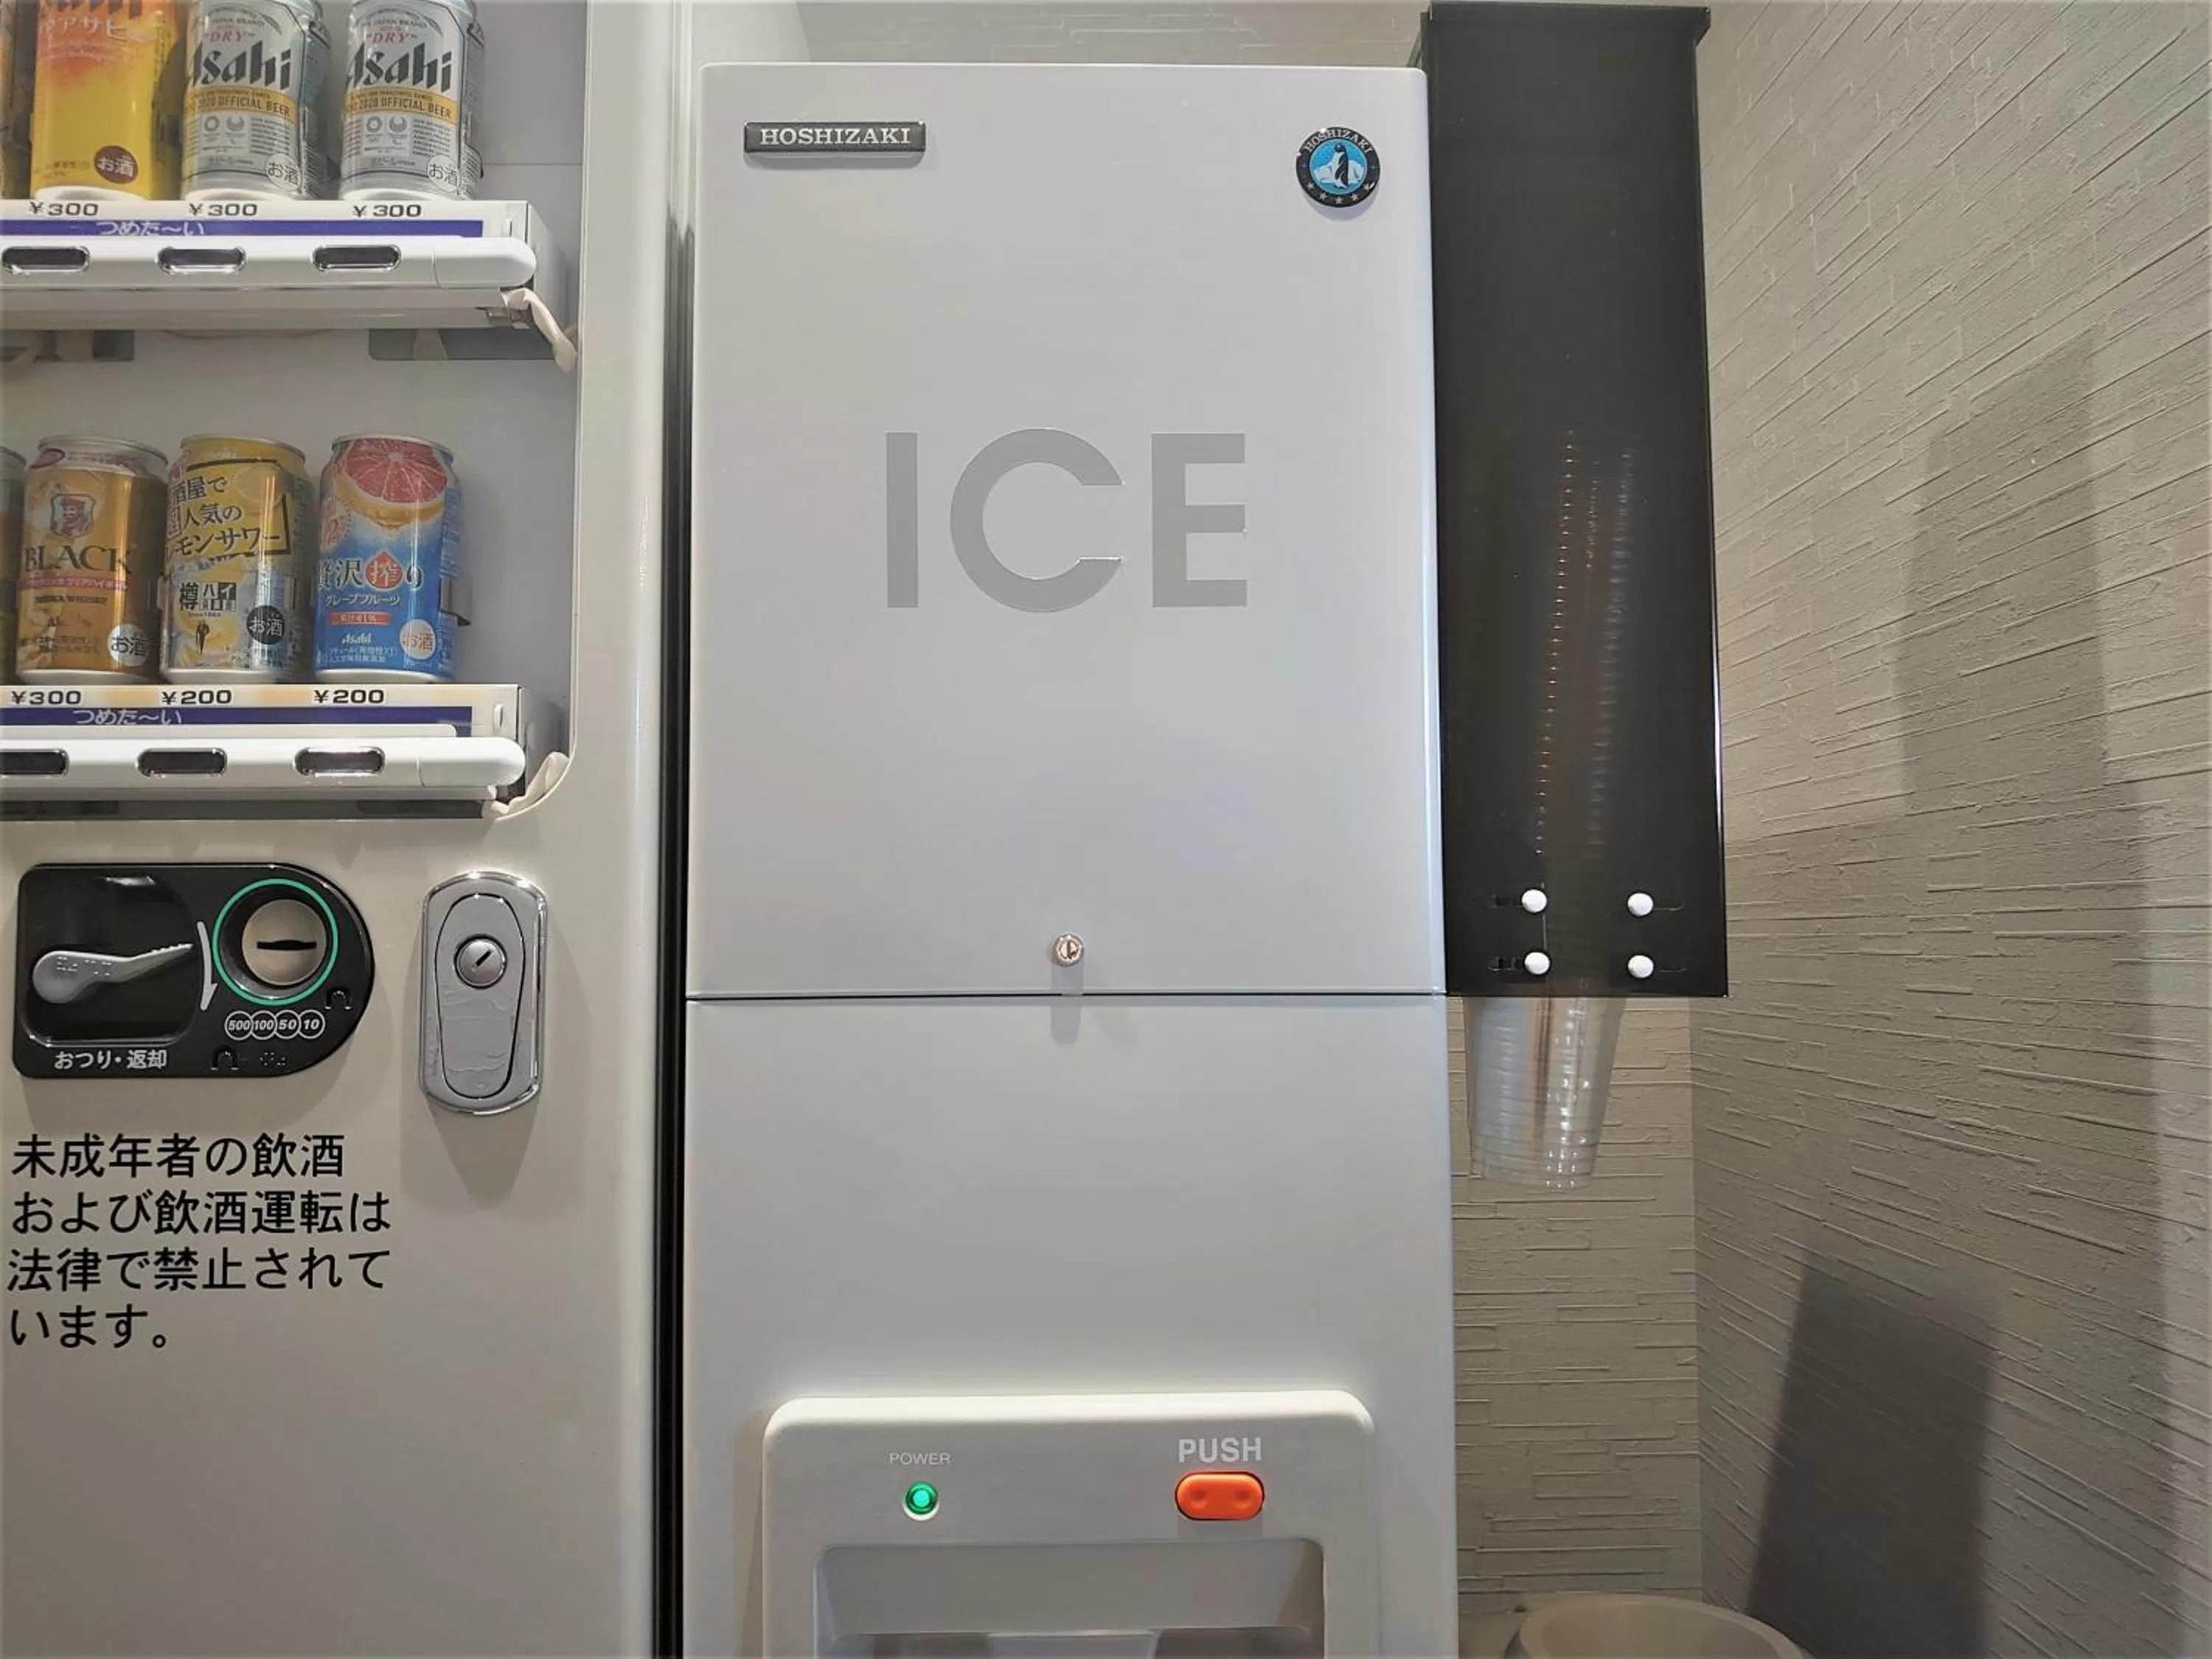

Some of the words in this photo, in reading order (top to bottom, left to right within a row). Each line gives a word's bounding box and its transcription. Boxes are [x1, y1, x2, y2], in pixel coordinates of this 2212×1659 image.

[192, 41, 292, 90] Asahi
[347, 42, 452, 93] Asahi
[380, 97, 425, 111] OFFICIAL
[760, 128, 912, 145] HOSHIZAKI
[1304, 128, 1374, 154] HOSHIZAKI
[97, 155, 134, 178] お酒
[268, 161, 299, 186] お酒
[428, 163, 459, 186] お酒
[30, 202, 98, 216] ¥300
[189, 204, 257, 216] ¥300
[354, 204, 422, 218] ¥300
[886, 426, 1248, 613] ICE
[24, 545, 132, 574] BLACK
[250, 613, 283, 637] お酒
[111, 633, 150, 657] お酒
[341, 633, 372, 644] Asahi
[402, 630, 434, 650] お酒
[11, 690, 82, 705] ¥300
[161, 689, 232, 705] ¥200
[314, 689, 384, 704] ¥200
[227, 1019, 251, 1032] 500
[254, 1019, 275, 1032] 100
[278, 1018, 297, 1032] 50
[302, 1018, 320, 1032] 10
[55, 1051, 167, 1068] おつり・返却
[11, 1133, 344, 1178] 未成年者の飲酒
[12, 1189, 391, 1234] および飲酒運転は
[7, 1247, 390, 1291] 法律で禁止されて
[11, 1304, 167, 1348] います。
[889, 1453, 951, 1465] POWER
[1179, 1437, 1262, 1463] PUSH
